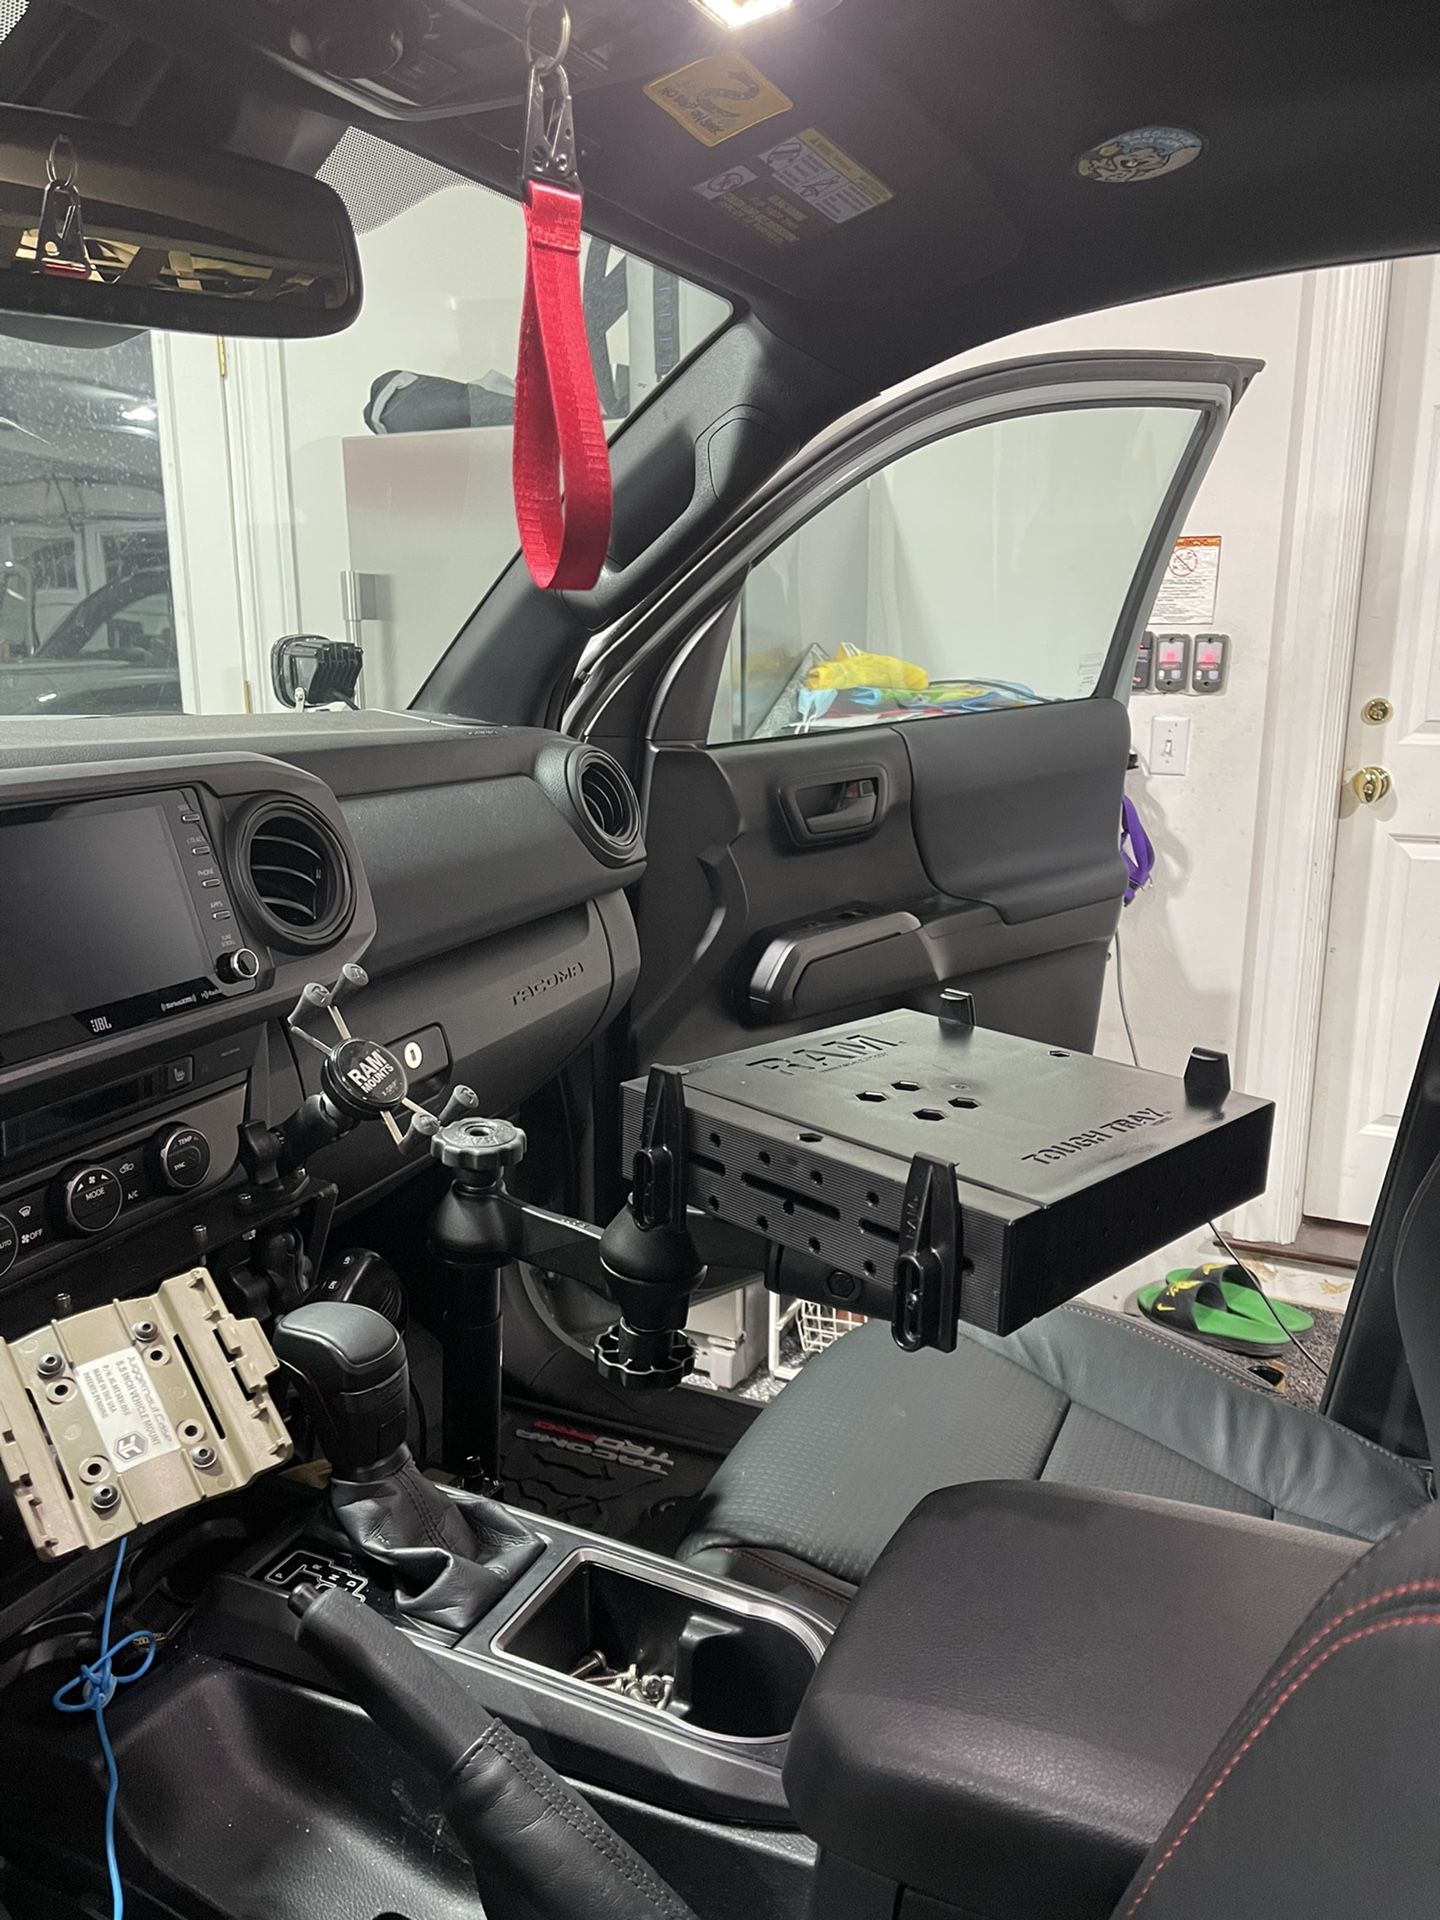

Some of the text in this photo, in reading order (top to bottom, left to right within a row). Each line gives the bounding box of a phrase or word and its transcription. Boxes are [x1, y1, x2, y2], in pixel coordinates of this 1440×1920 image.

[506, 961, 584, 1006] TACOMA
[90, 1016, 112, 1033] JBL
[745, 1034, 899, 1076] RAM
[346, 1050, 388, 1087] RAM
[360, 1063, 395, 1094] MOUNTS
[178, 1134, 193, 1147] TEMP
[1021, 1107, 1165, 1165] TOUGH TRAY
[174, 1161, 186, 1171] SYNC
[85, 1186, 106, 1201] MODE
[127, 1189, 139, 1201] A/C
[0, 1239, 13, 1249] UTO
[29, 1228, 43, 1240] OFF
[121, 1372, 134, 1391] INCH
[129, 1388, 149, 1420] VEHICLE
[143, 1419, 162, 1446] MOUNT
[515, 1428, 669, 1476] TACOMA
[594, 1436, 675, 1467] TRD
[328, 1573, 340, 1581] N
